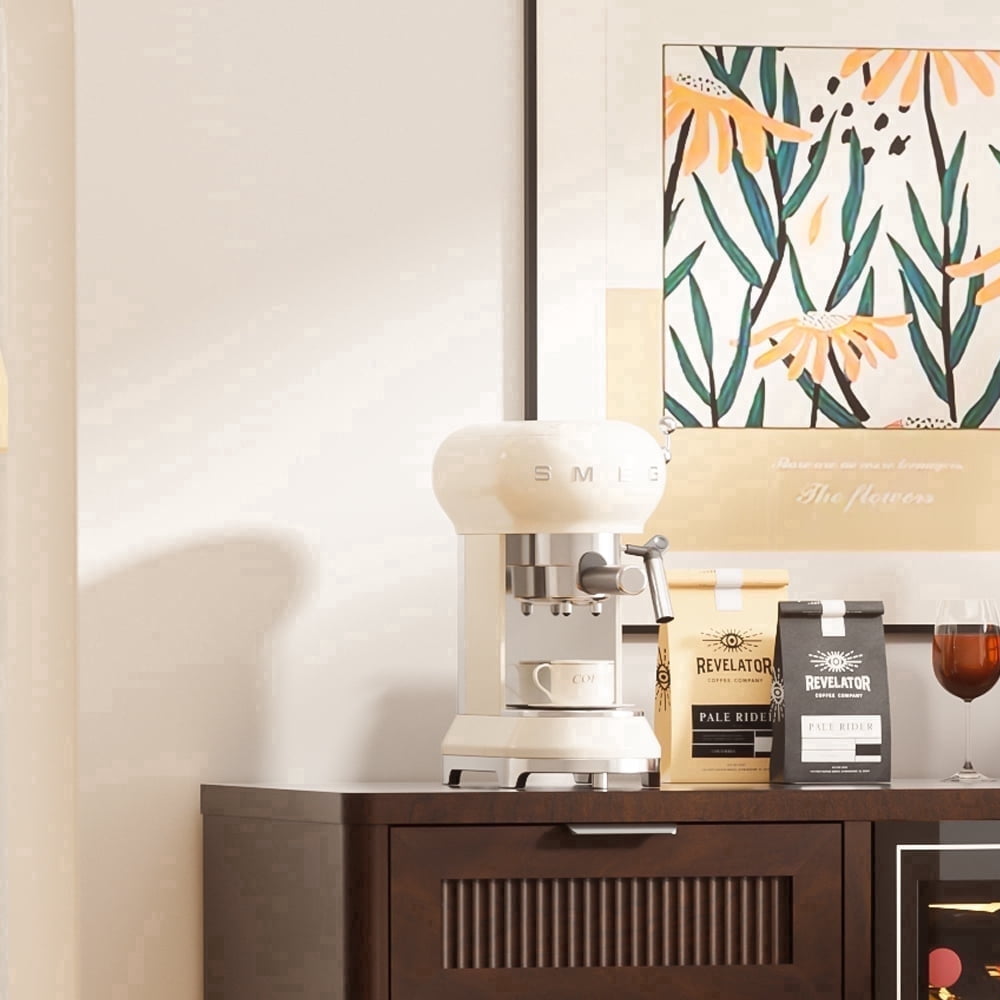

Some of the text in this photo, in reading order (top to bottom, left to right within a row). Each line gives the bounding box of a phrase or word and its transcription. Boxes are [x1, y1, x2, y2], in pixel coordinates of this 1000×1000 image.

[796, 482, 935, 513] The flowers
[696, 657, 773, 675] REVELATOR
[805, 674, 872, 692] REVELATOR
[700, 712, 772, 722] PALE RIDE
[808, 722, 873, 732] PALE RIDER
